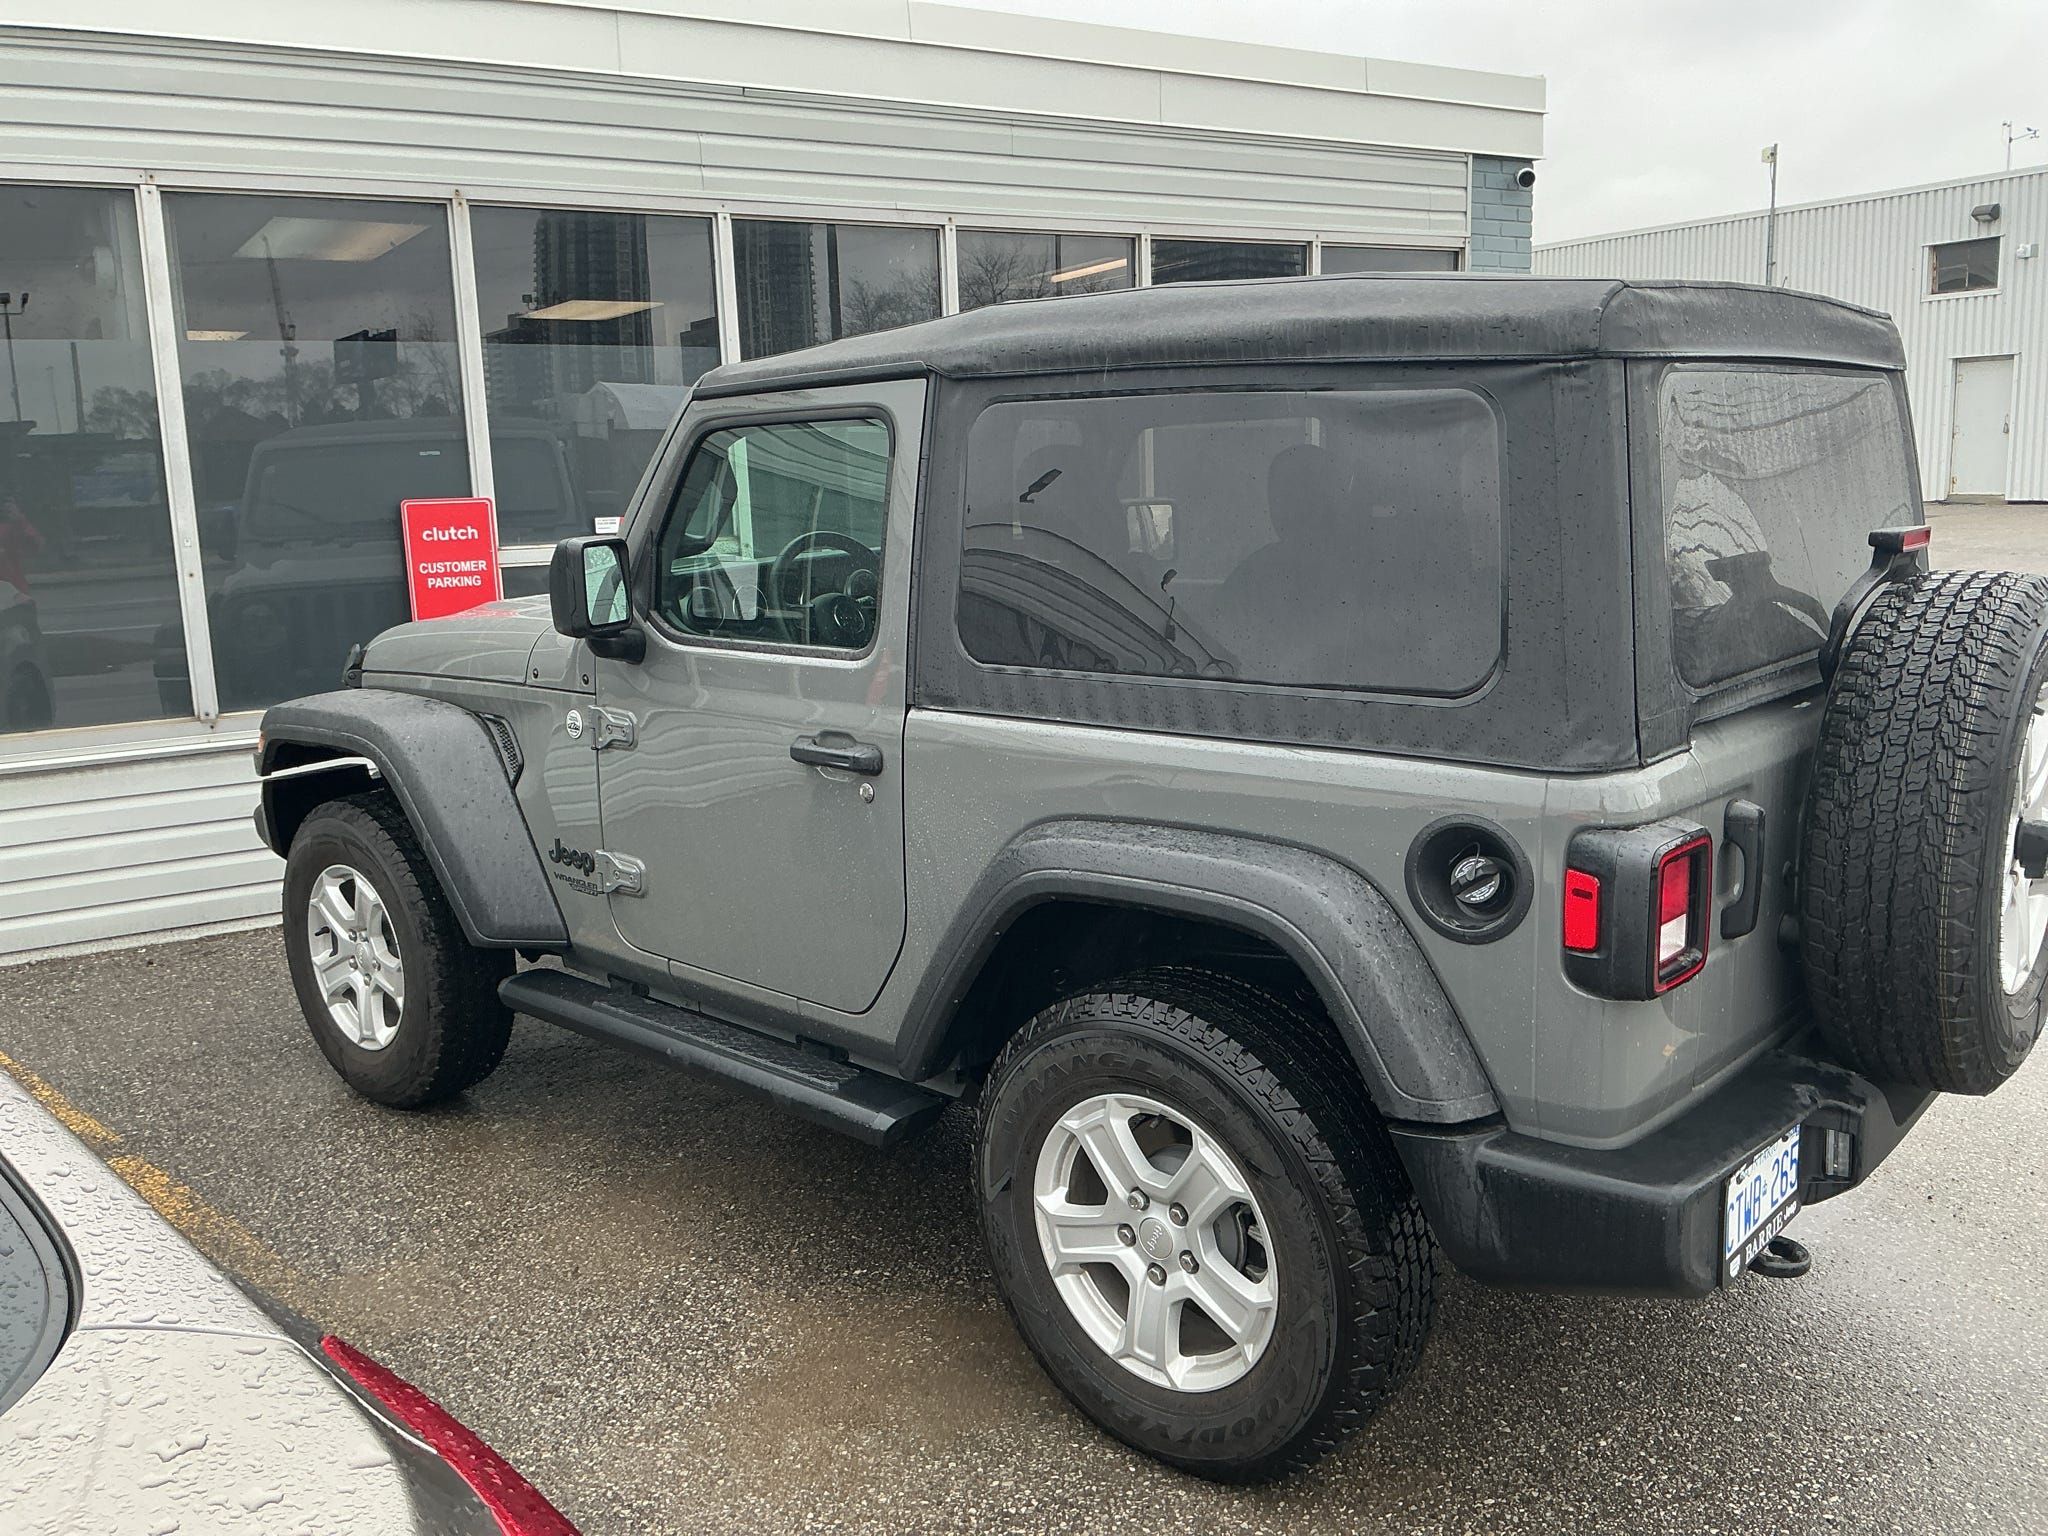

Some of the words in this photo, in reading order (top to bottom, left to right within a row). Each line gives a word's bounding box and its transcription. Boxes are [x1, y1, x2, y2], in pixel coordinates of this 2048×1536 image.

[422, 525, 479, 542] clutch
[419, 560, 487, 575] CUSTOMER
[427, 575, 482, 589] PARKING
[549, 837, 596, 876] Jeep
[1726, 1174, 1762, 1254] CTWB
[1770, 1141, 1800, 1208] 265
[1745, 1211, 1783, 1265] BARRIE
